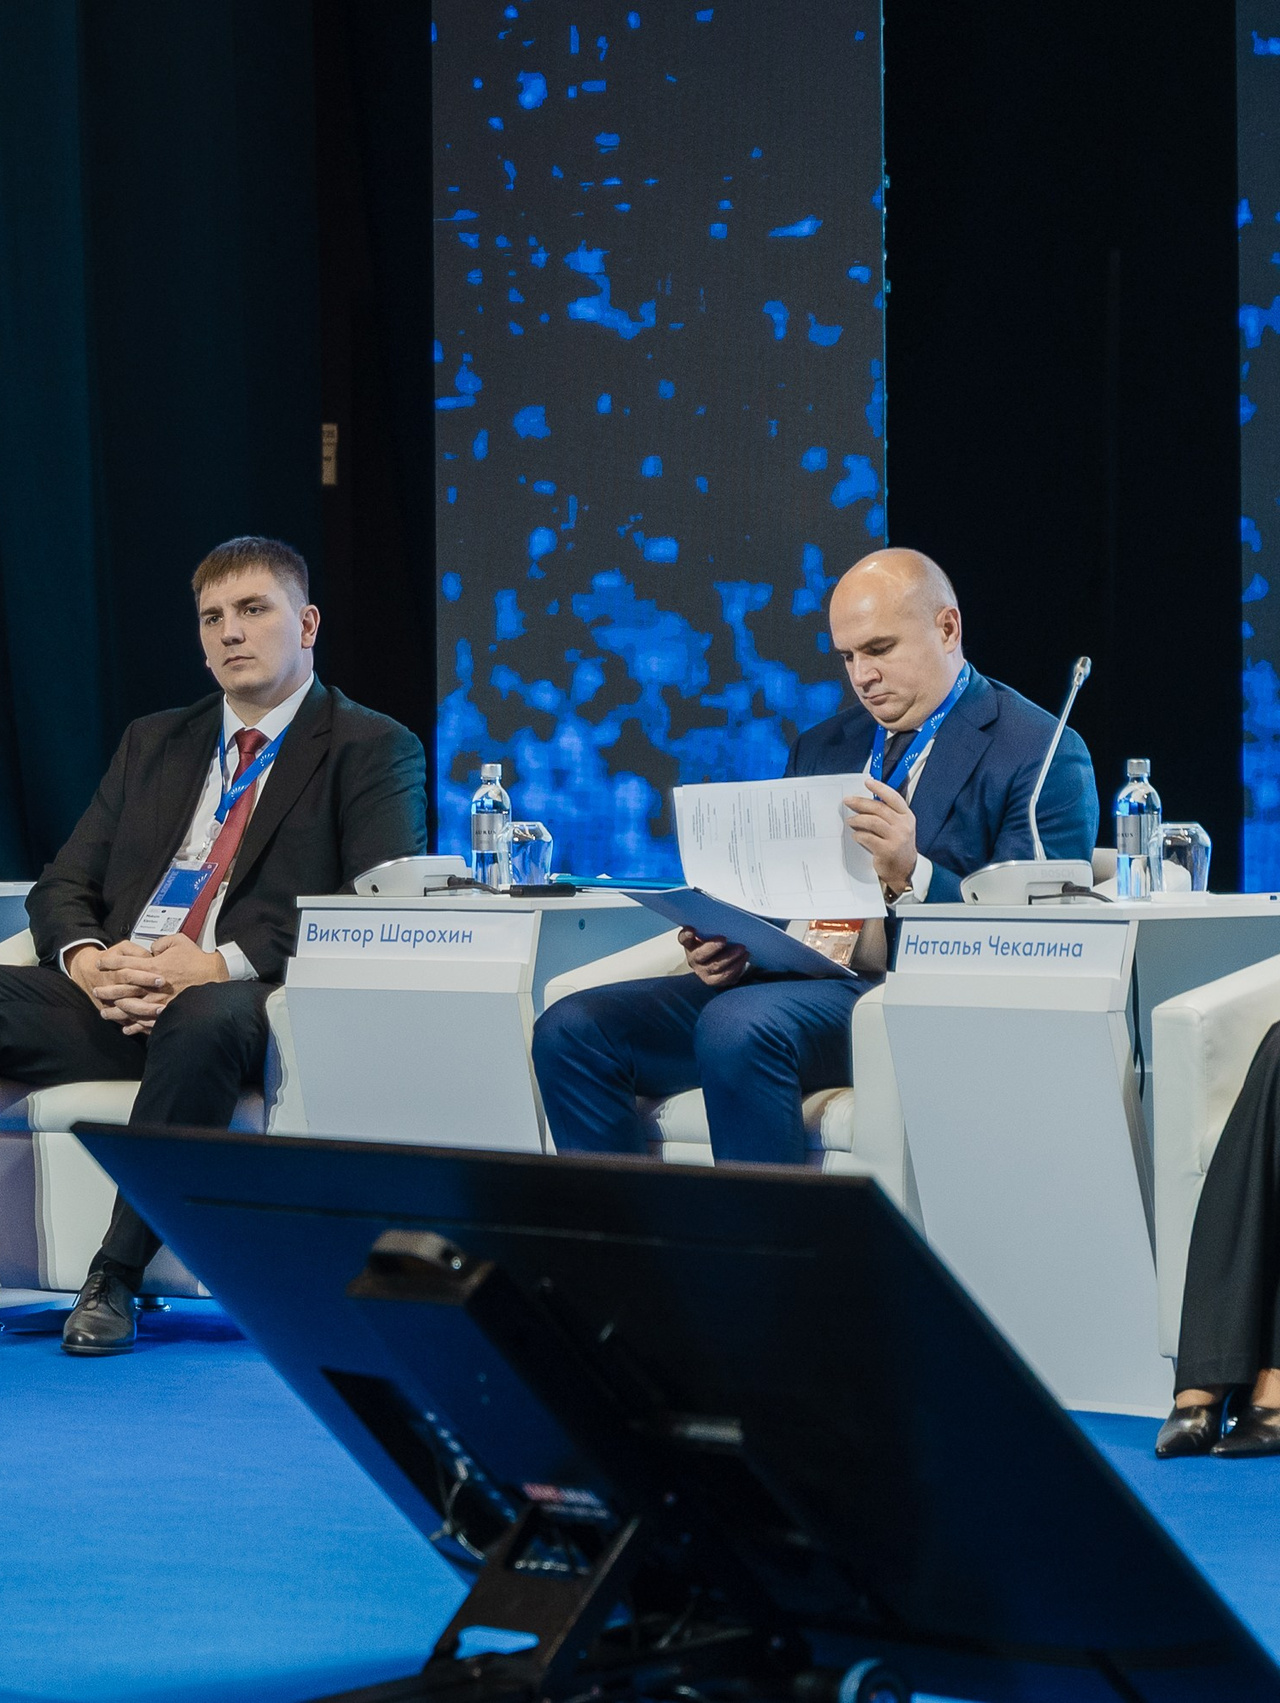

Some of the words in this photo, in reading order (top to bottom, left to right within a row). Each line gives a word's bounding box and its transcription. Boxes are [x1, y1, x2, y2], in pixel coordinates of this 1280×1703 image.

[306, 923, 374, 948] Виктор
[380, 923, 473, 949] Шарохин
[904, 934, 982, 956] Наталья
[988, 935, 1084, 958] Чекалина
